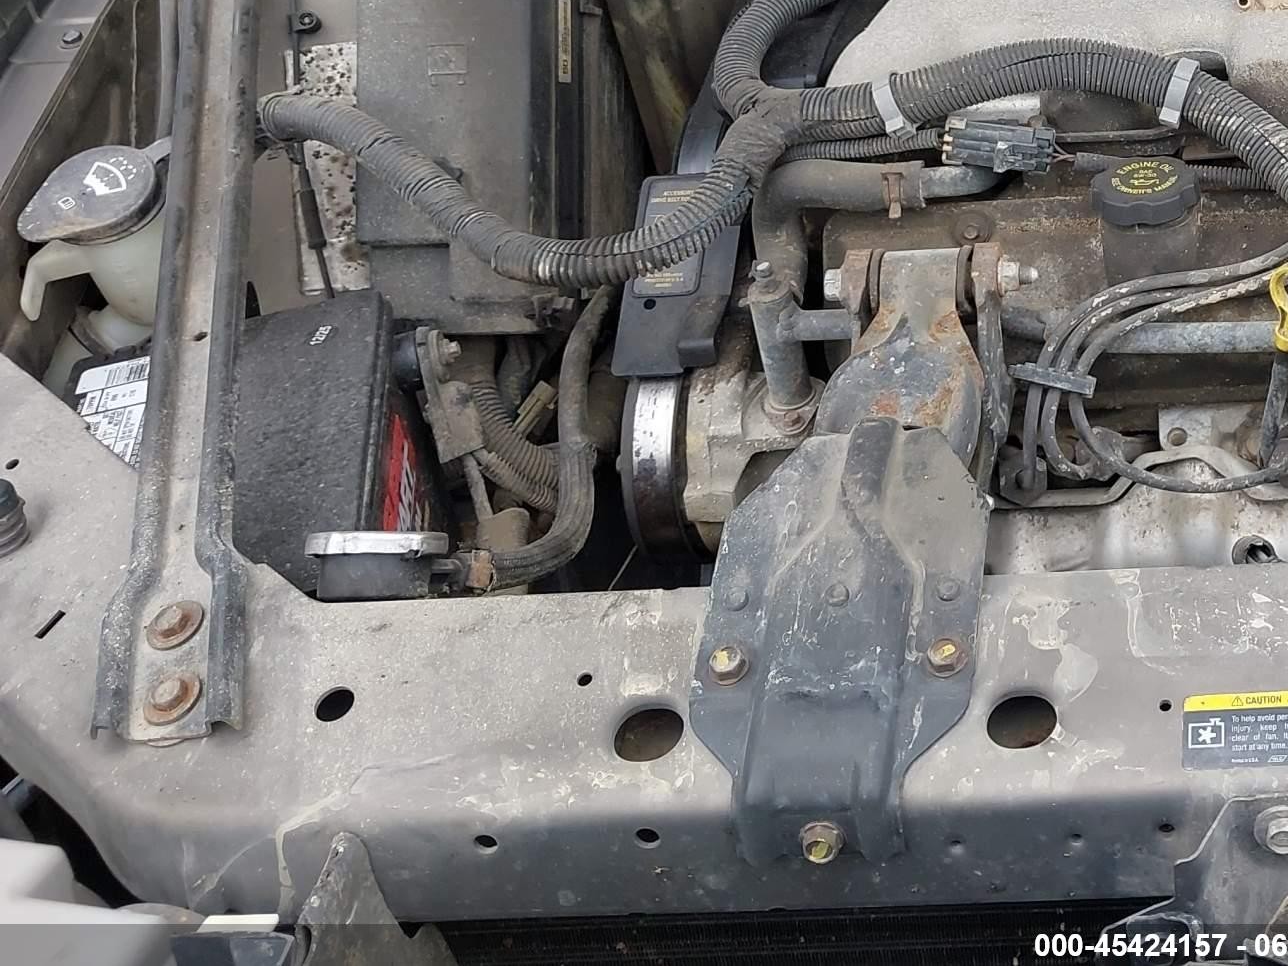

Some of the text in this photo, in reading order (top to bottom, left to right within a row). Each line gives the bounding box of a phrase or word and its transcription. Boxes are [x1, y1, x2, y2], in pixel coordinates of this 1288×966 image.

[1116, 162, 1175, 174] ENGINE OIL
[308, 324, 332, 346] 12/25
[1246, 696, 1281, 704] CAUTION
[1260, 724, 1277, 732] keep
[1253, 732, 1260, 740] of
